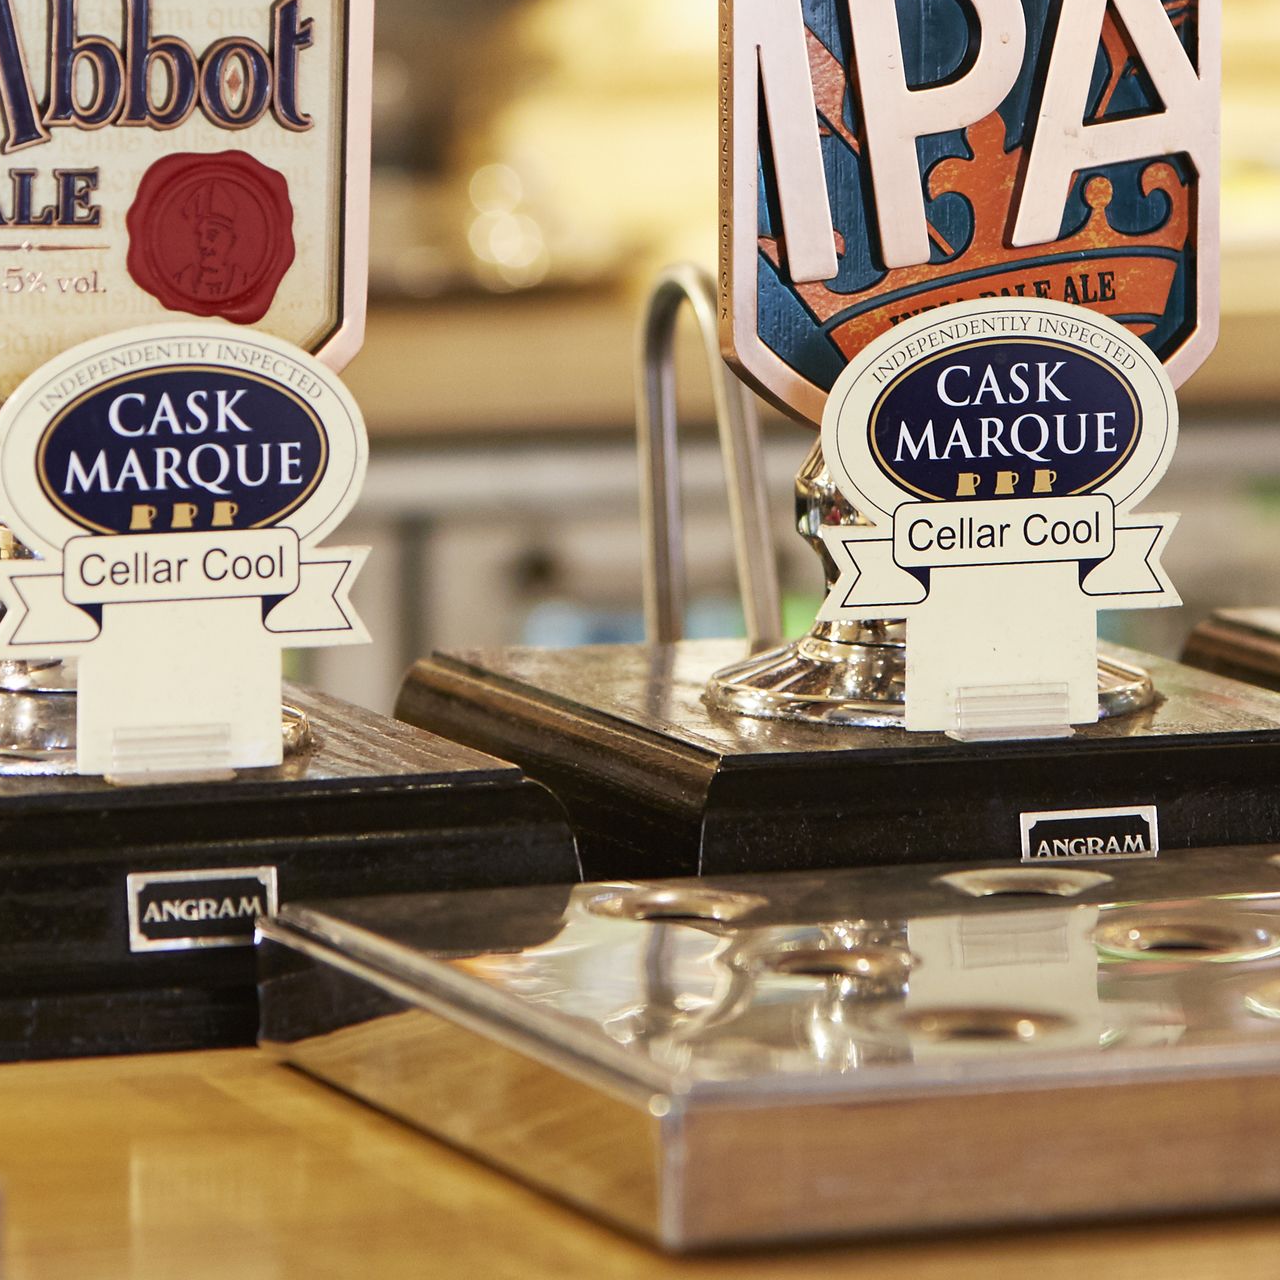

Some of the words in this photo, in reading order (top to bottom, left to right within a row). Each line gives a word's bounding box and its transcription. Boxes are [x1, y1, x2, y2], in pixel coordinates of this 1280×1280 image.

[57, 270, 108, 294] vol.
[1063, 271, 1117, 305] ALE
[870, 315, 1032, 385] INDEPENDENTLY
[1037, 316, 1137, 372] INSPECTED
[38, 342, 210, 413] INDEPENDENTLY
[216, 343, 323, 401] INSPECTED
[935, 360, 1071, 408] CASK
[107, 388, 253, 438] CASK
[892, 411, 1119, 463] MARQUE
[62, 441, 304, 495] MARQUE
[907, 517, 1011, 551] Cellar
[1022, 510, 1101, 546] Cool
[79, 551, 189, 587] Cellar
[201, 545, 285, 582] Cool
[1036, 834, 1147, 858] ANGRAM
[142, 894, 263, 924] ANGRAM
